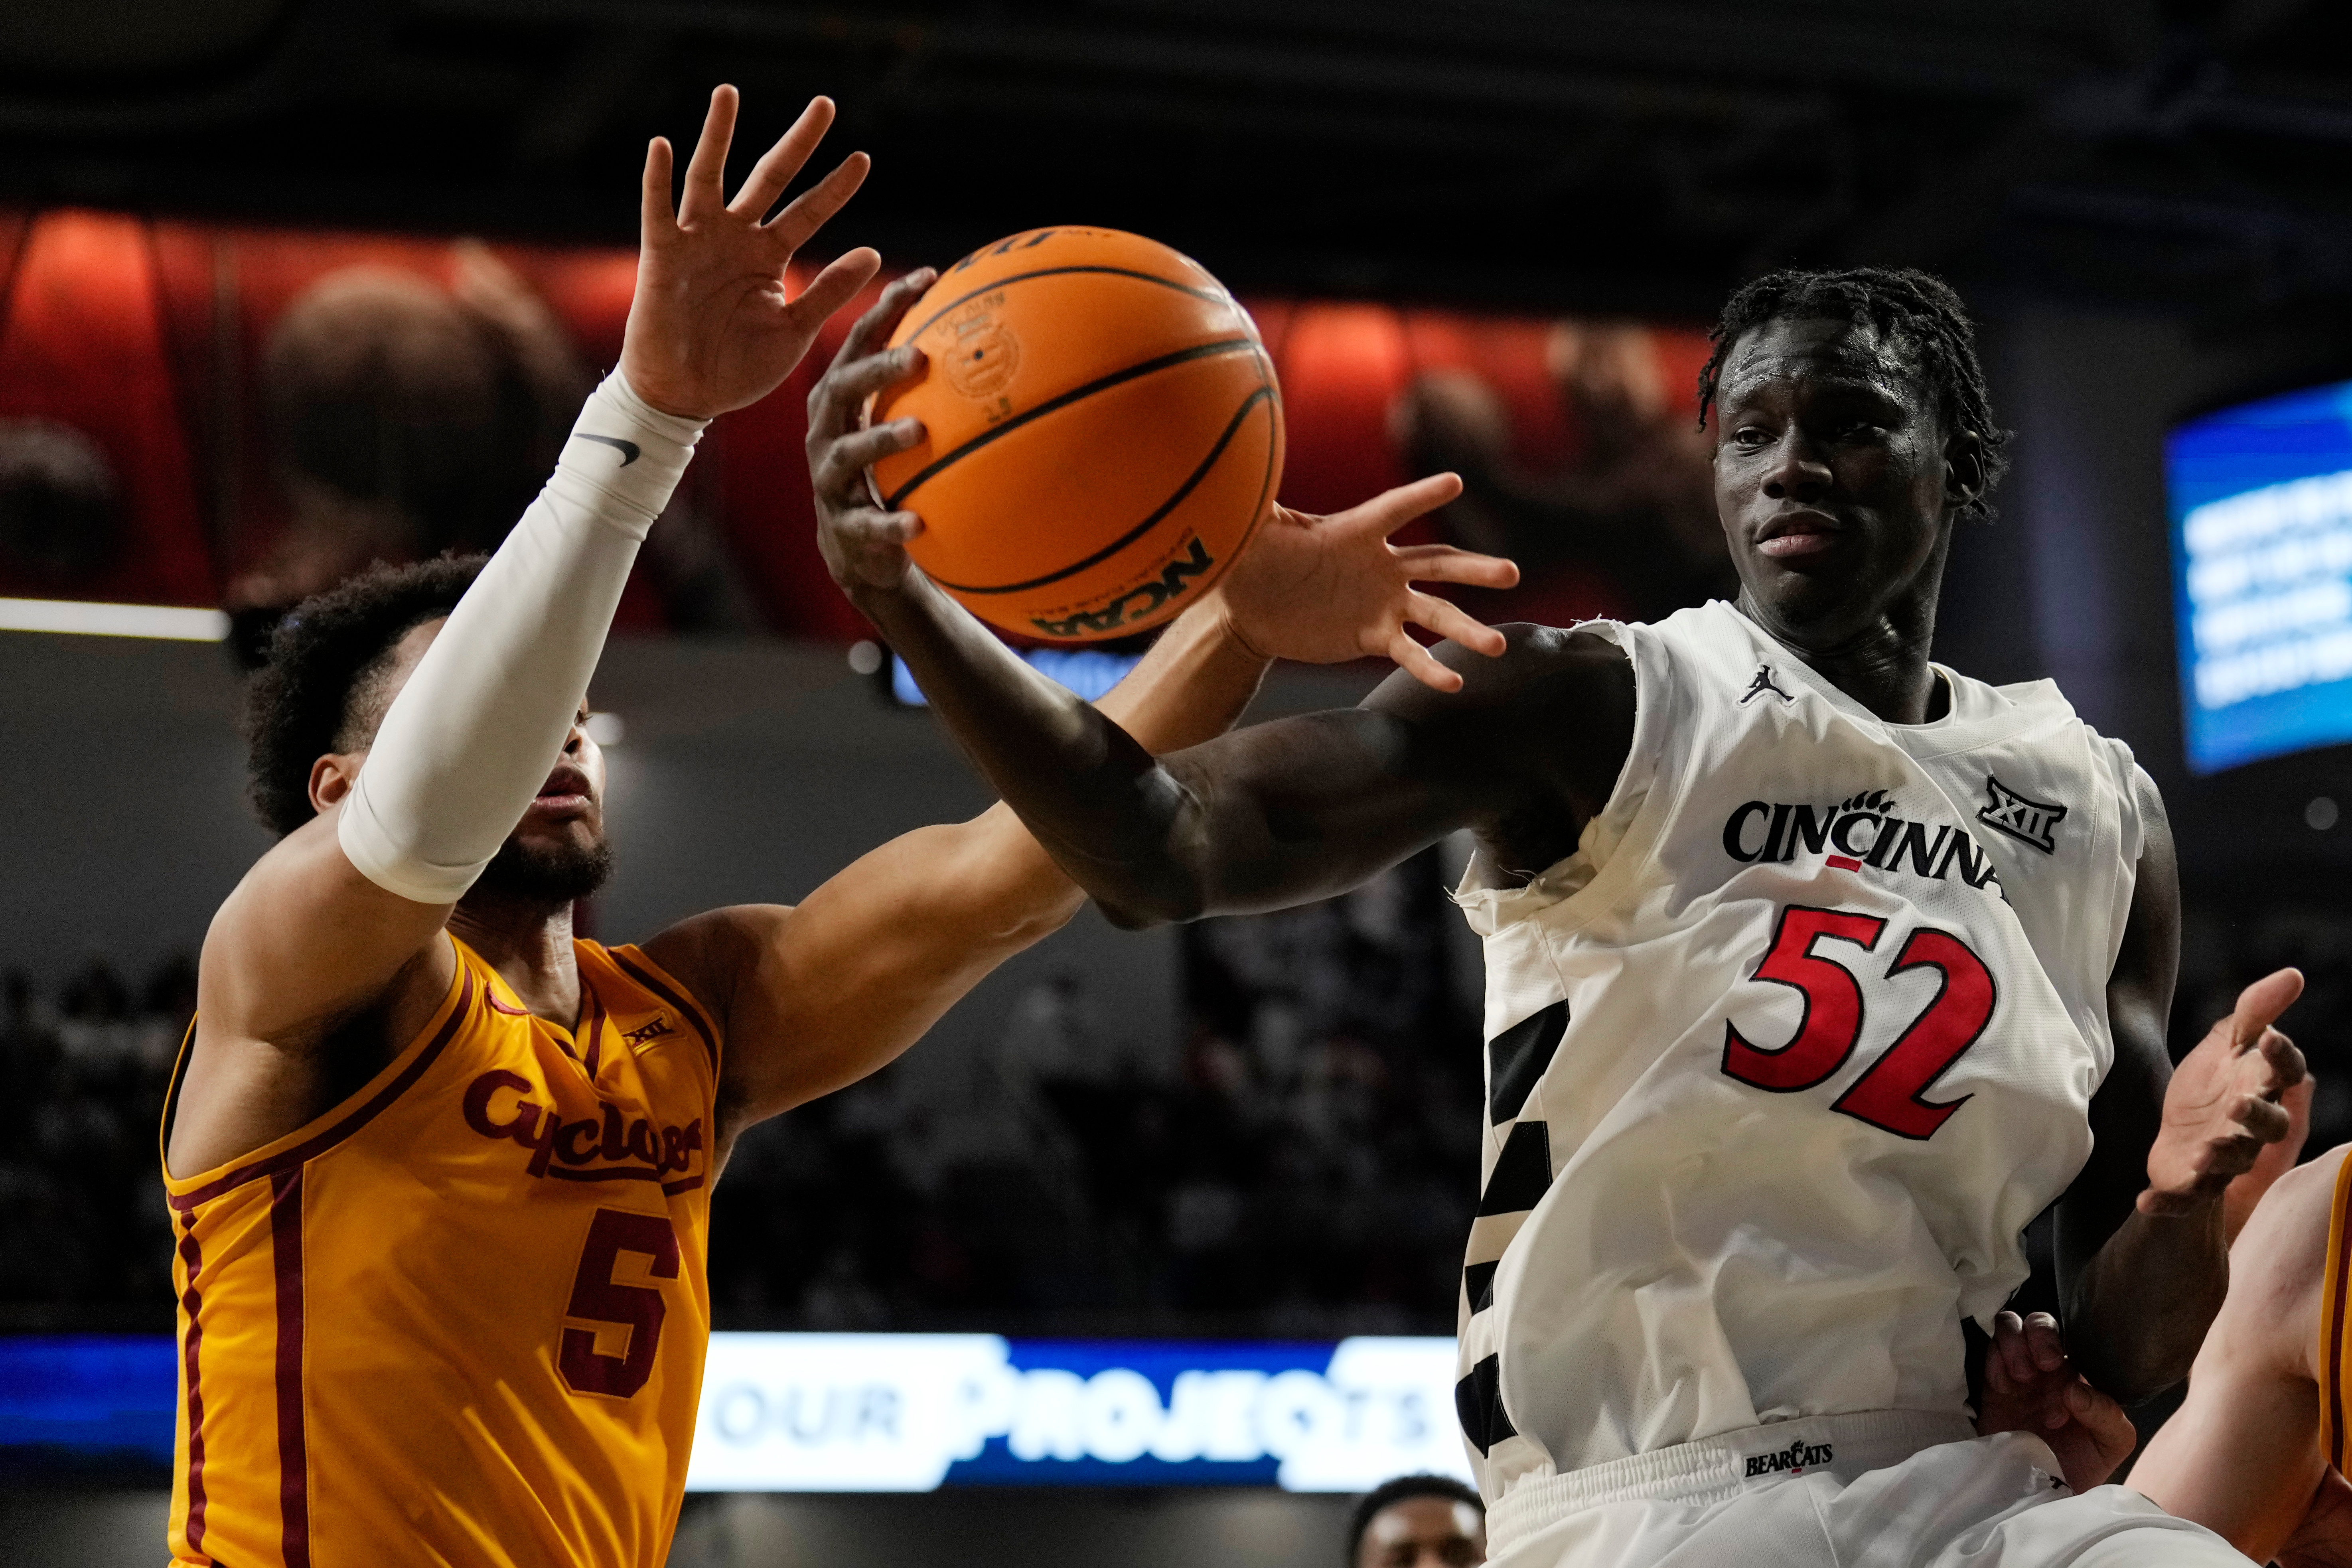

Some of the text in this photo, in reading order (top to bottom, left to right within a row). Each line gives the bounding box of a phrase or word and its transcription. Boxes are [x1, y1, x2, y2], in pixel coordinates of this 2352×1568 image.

[1030, 536, 1214, 635] NCAA
[1979, 778, 2065, 851] XII
[1721, 904, 1995, 1141] 52
[558, 1207, 680, 1399] 5
[713, 1383, 902, 1446] OUR
[1745, 1441, 1833, 1477] BEARCATS
